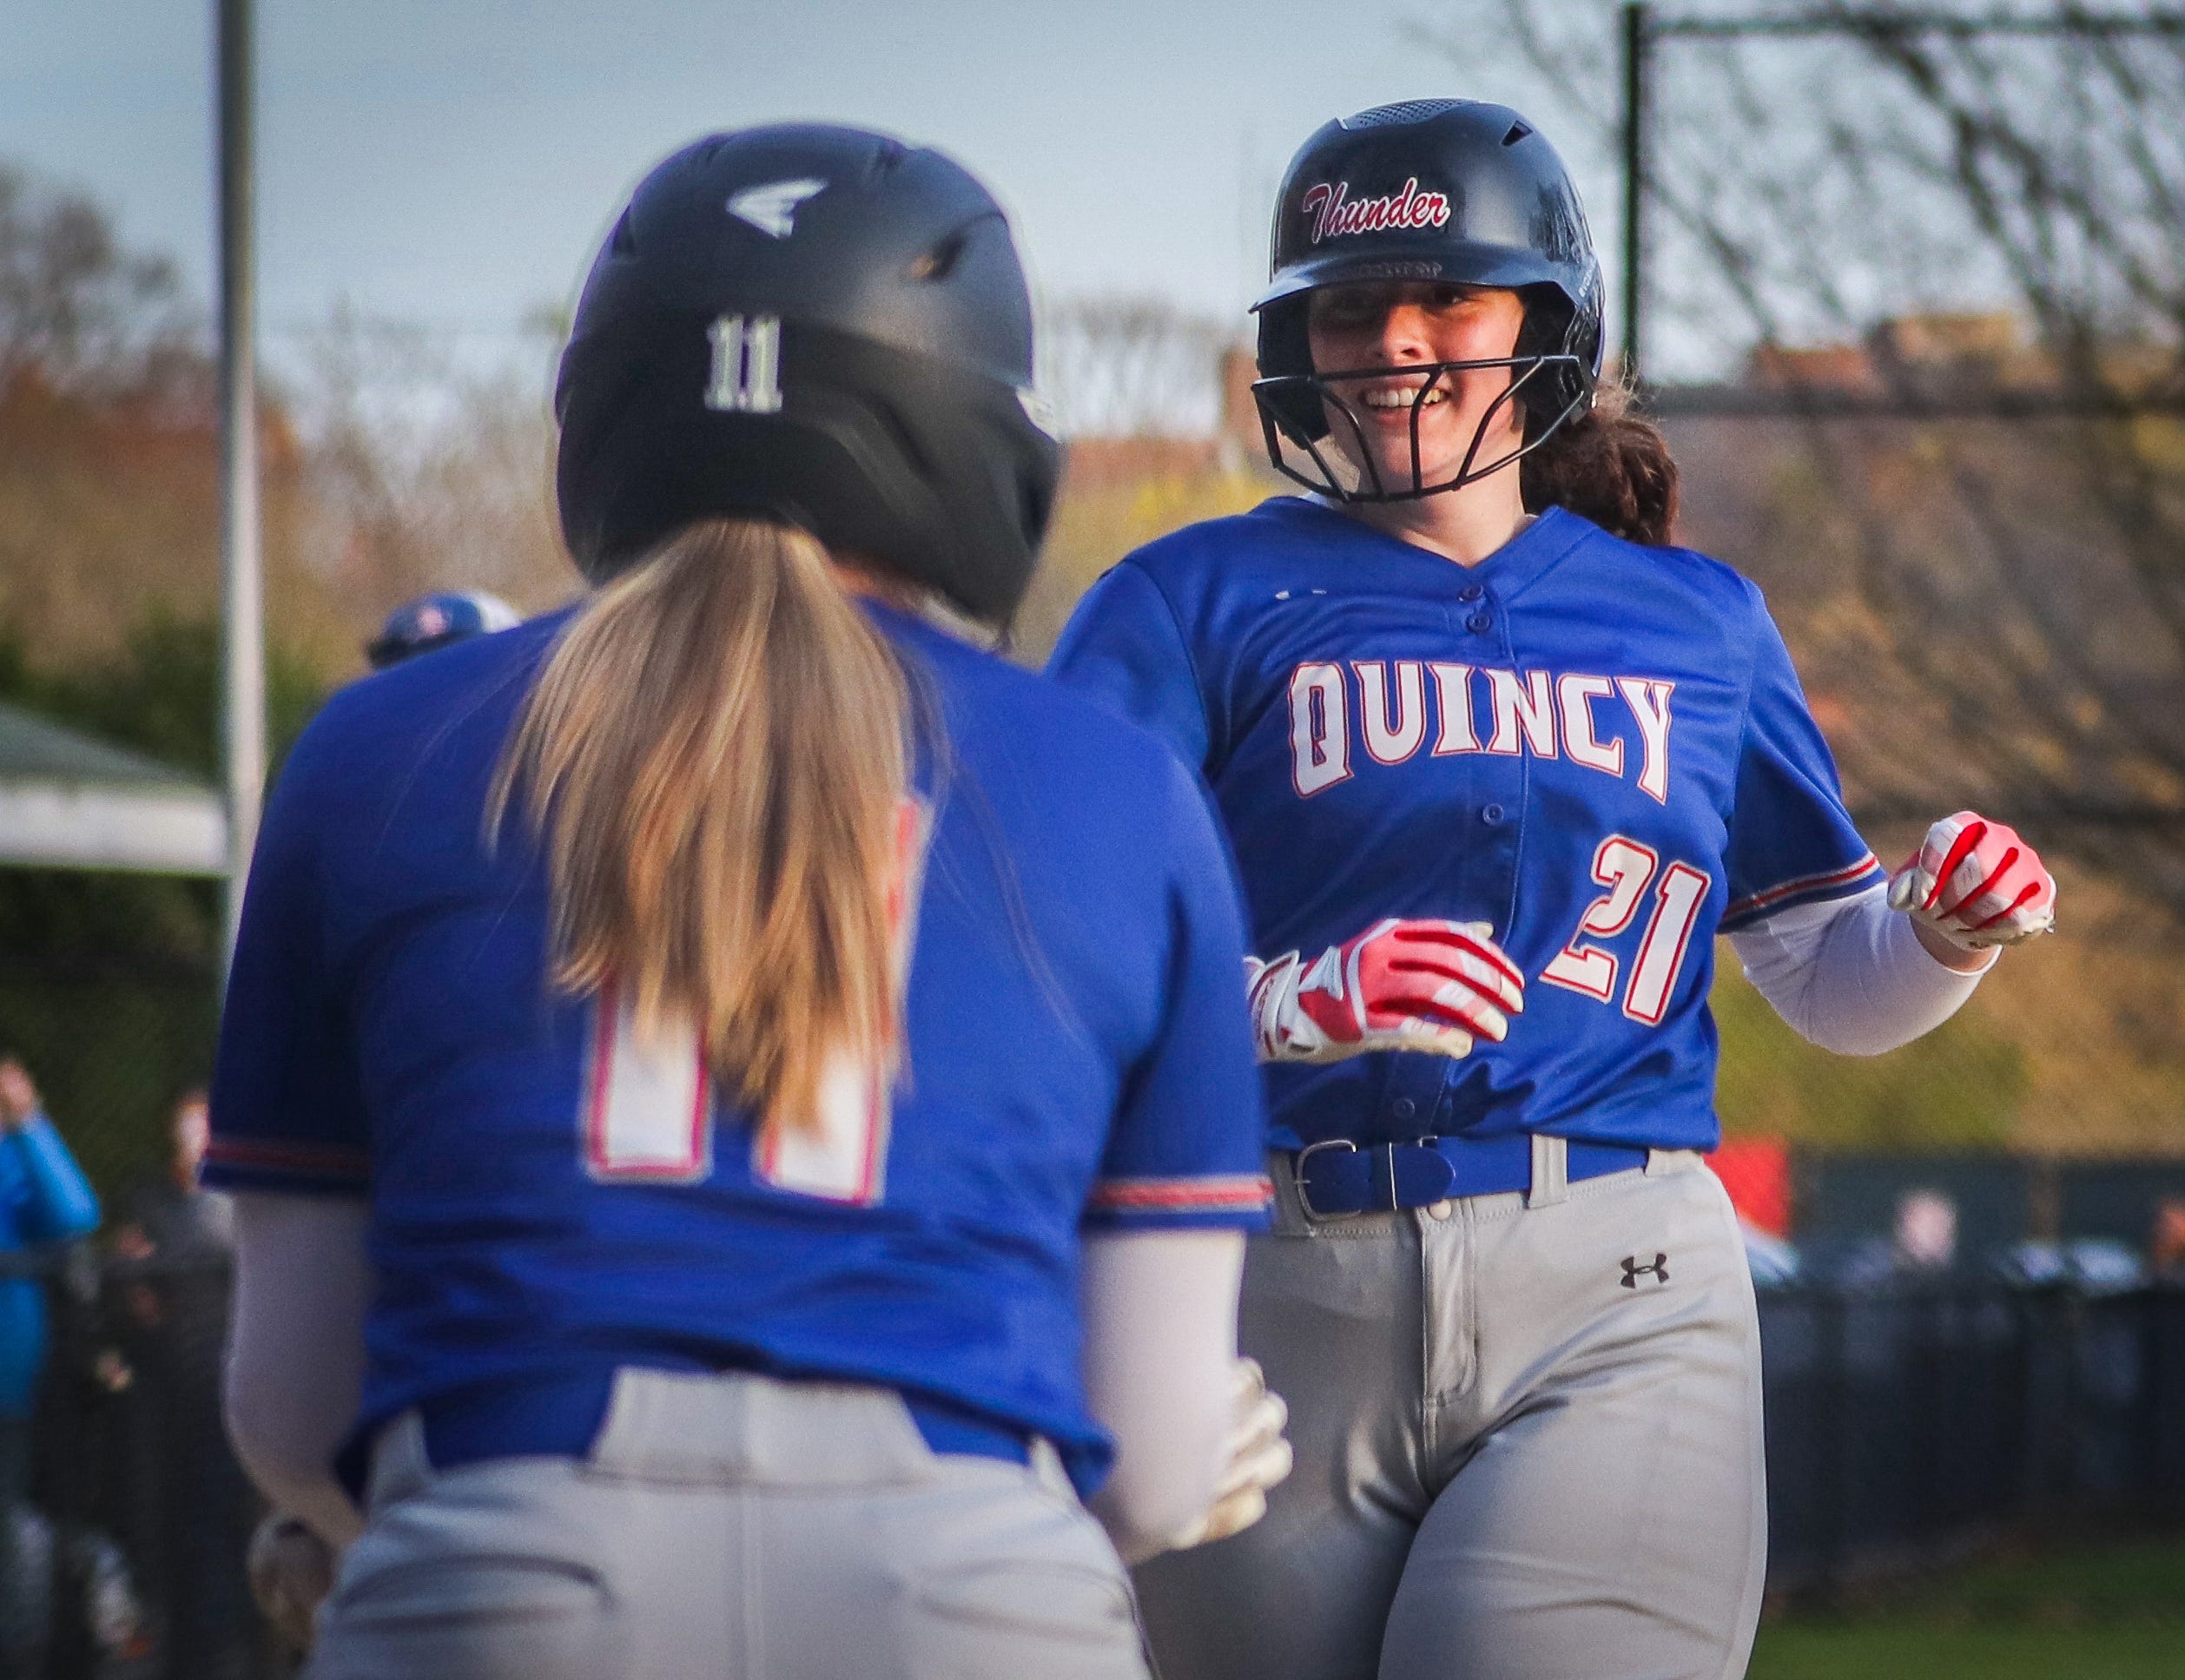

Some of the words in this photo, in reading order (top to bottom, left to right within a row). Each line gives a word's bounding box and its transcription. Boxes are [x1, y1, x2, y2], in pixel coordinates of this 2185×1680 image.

[1304, 176, 1451, 244] Thunder
[704, 313, 782, 414] 11
[1288, 660, 1676, 806] QUINCY
[1539, 833, 1713, 1026] 21
